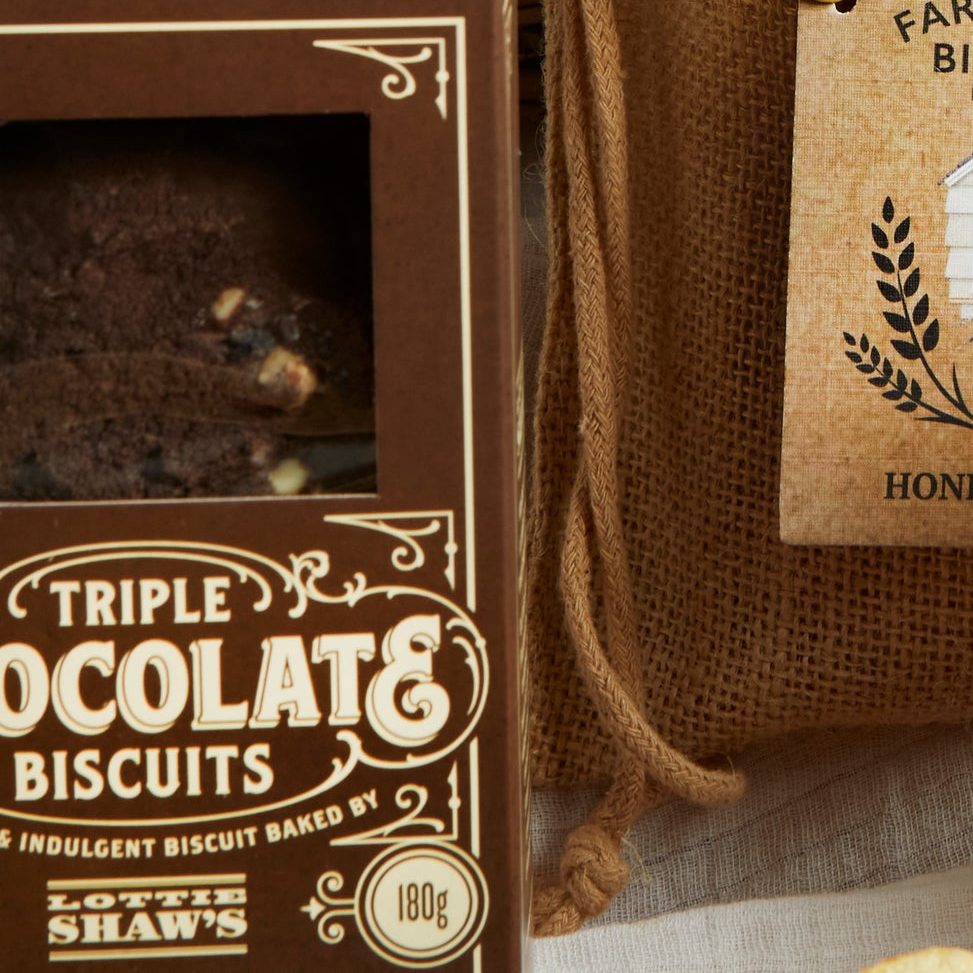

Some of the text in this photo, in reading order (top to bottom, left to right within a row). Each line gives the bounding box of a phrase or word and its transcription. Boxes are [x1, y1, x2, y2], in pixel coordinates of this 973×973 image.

[50, 577, 232, 627] TRIPLE
[14, 743, 274, 802] BISCUITS
[19, 831, 157, 859] INDULGENT
[163, 827, 258, 858] BISCUIT
[265, 804, 344, 841] BAKED
[349, 789, 379, 817] BY
[47, 889, 247, 910] LOTTIE
[398, 882, 449, 929] 180g
[47, 909, 248, 945] SHAW'S
